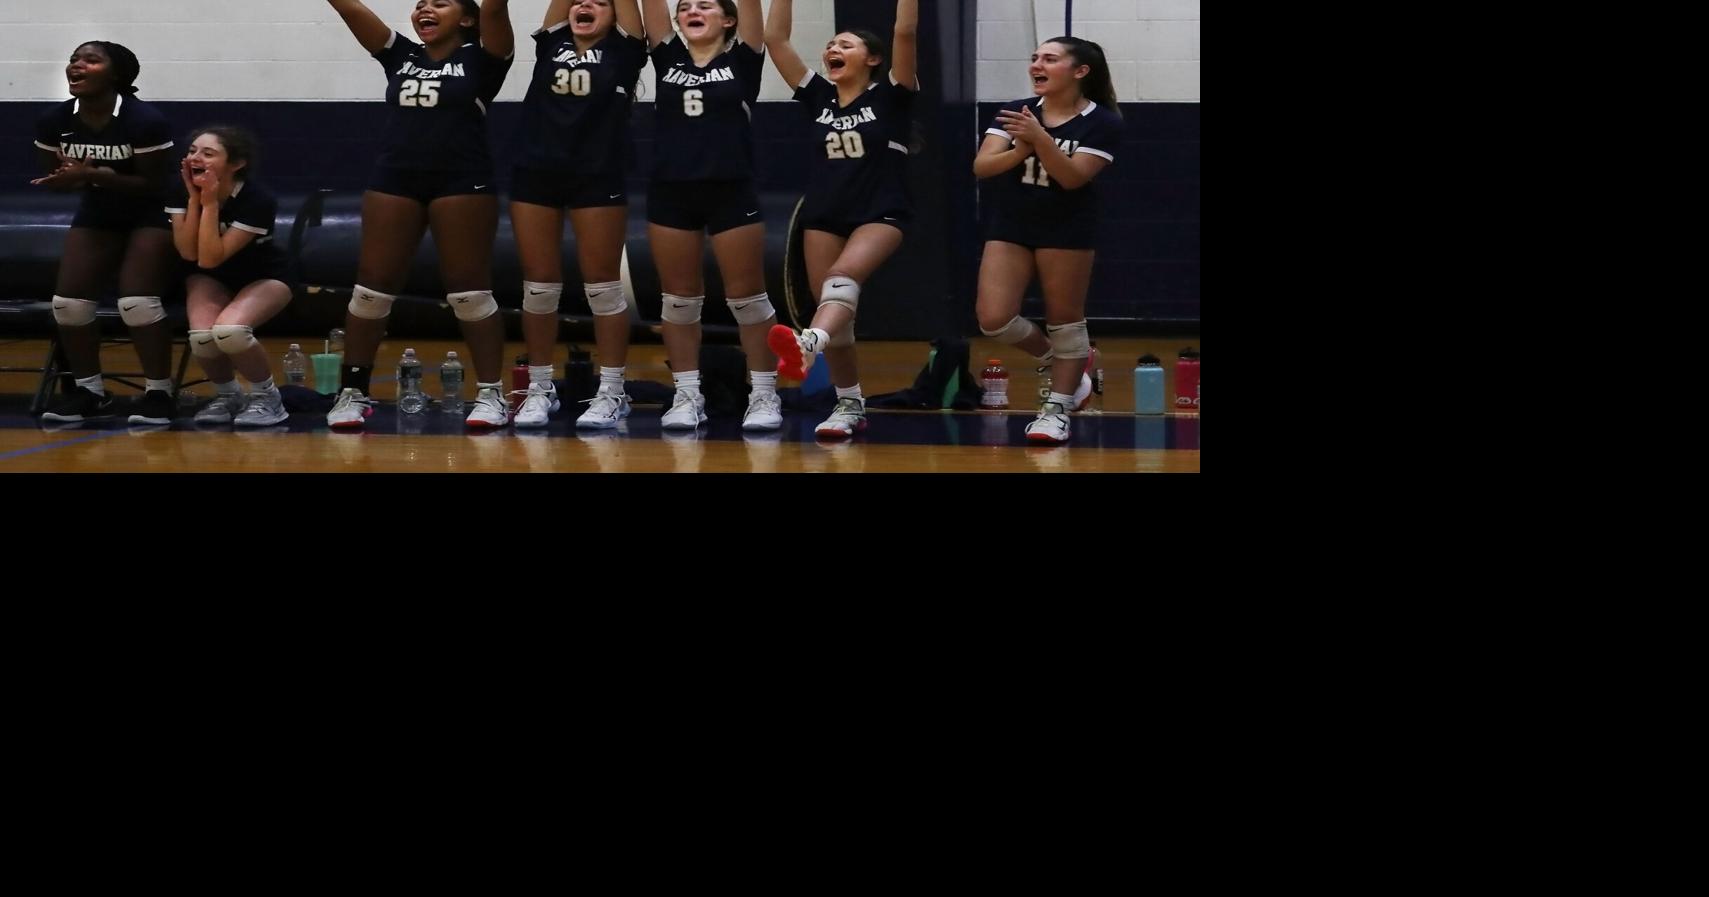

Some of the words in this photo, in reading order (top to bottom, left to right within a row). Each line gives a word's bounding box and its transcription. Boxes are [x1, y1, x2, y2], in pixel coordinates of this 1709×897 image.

[399, 79, 441, 107] 25
[551, 68, 591, 96] 30
[683, 89, 704, 116] 6
[825, 130, 865, 159] 20
[1021, 156, 1049, 187] 11
